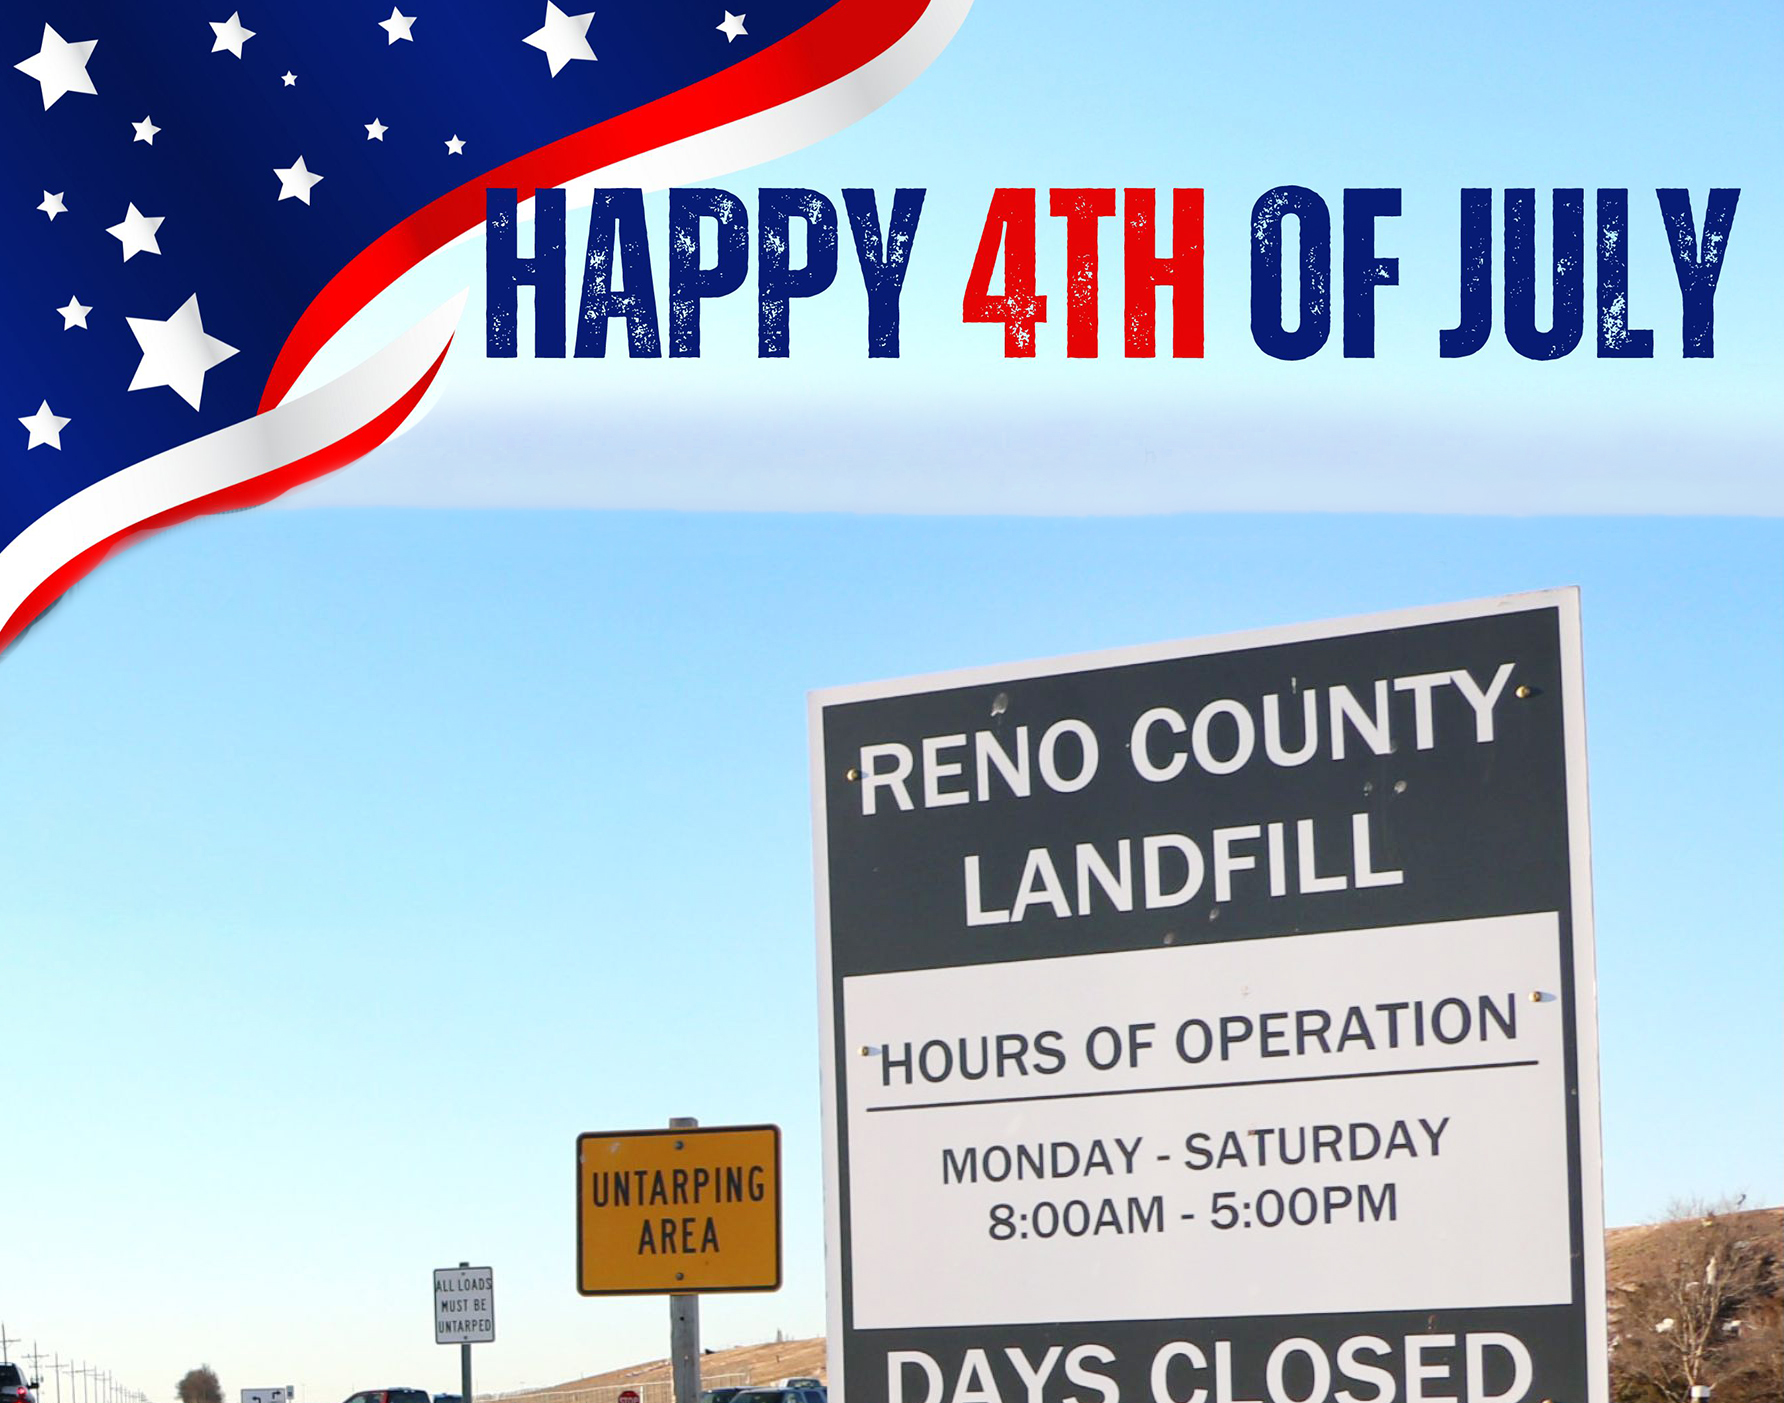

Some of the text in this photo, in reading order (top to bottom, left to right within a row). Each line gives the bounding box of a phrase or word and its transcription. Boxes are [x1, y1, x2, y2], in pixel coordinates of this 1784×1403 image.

[859, 663, 1515, 815] RENO COUNTY
[964, 813, 1403, 928] LANDFILL
[881, 992, 1517, 1086] HOURS OF OPERATION
[942, 1136, 1144, 1185] MONDAY
[1184, 1117, 1451, 1172] SATURDAY
[592, 1165, 766, 1207] UNTARPING
[638, 1217, 720, 1255] AREA
[989, 1195, 1164, 1241] 8:00AM
[1209, 1183, 1397, 1230] 5:00PM
[436, 1278, 492, 1292] ALL LOADS
[442, 1298, 486, 1312] MUST BE
[438, 1319, 491, 1333] UNTARPED
